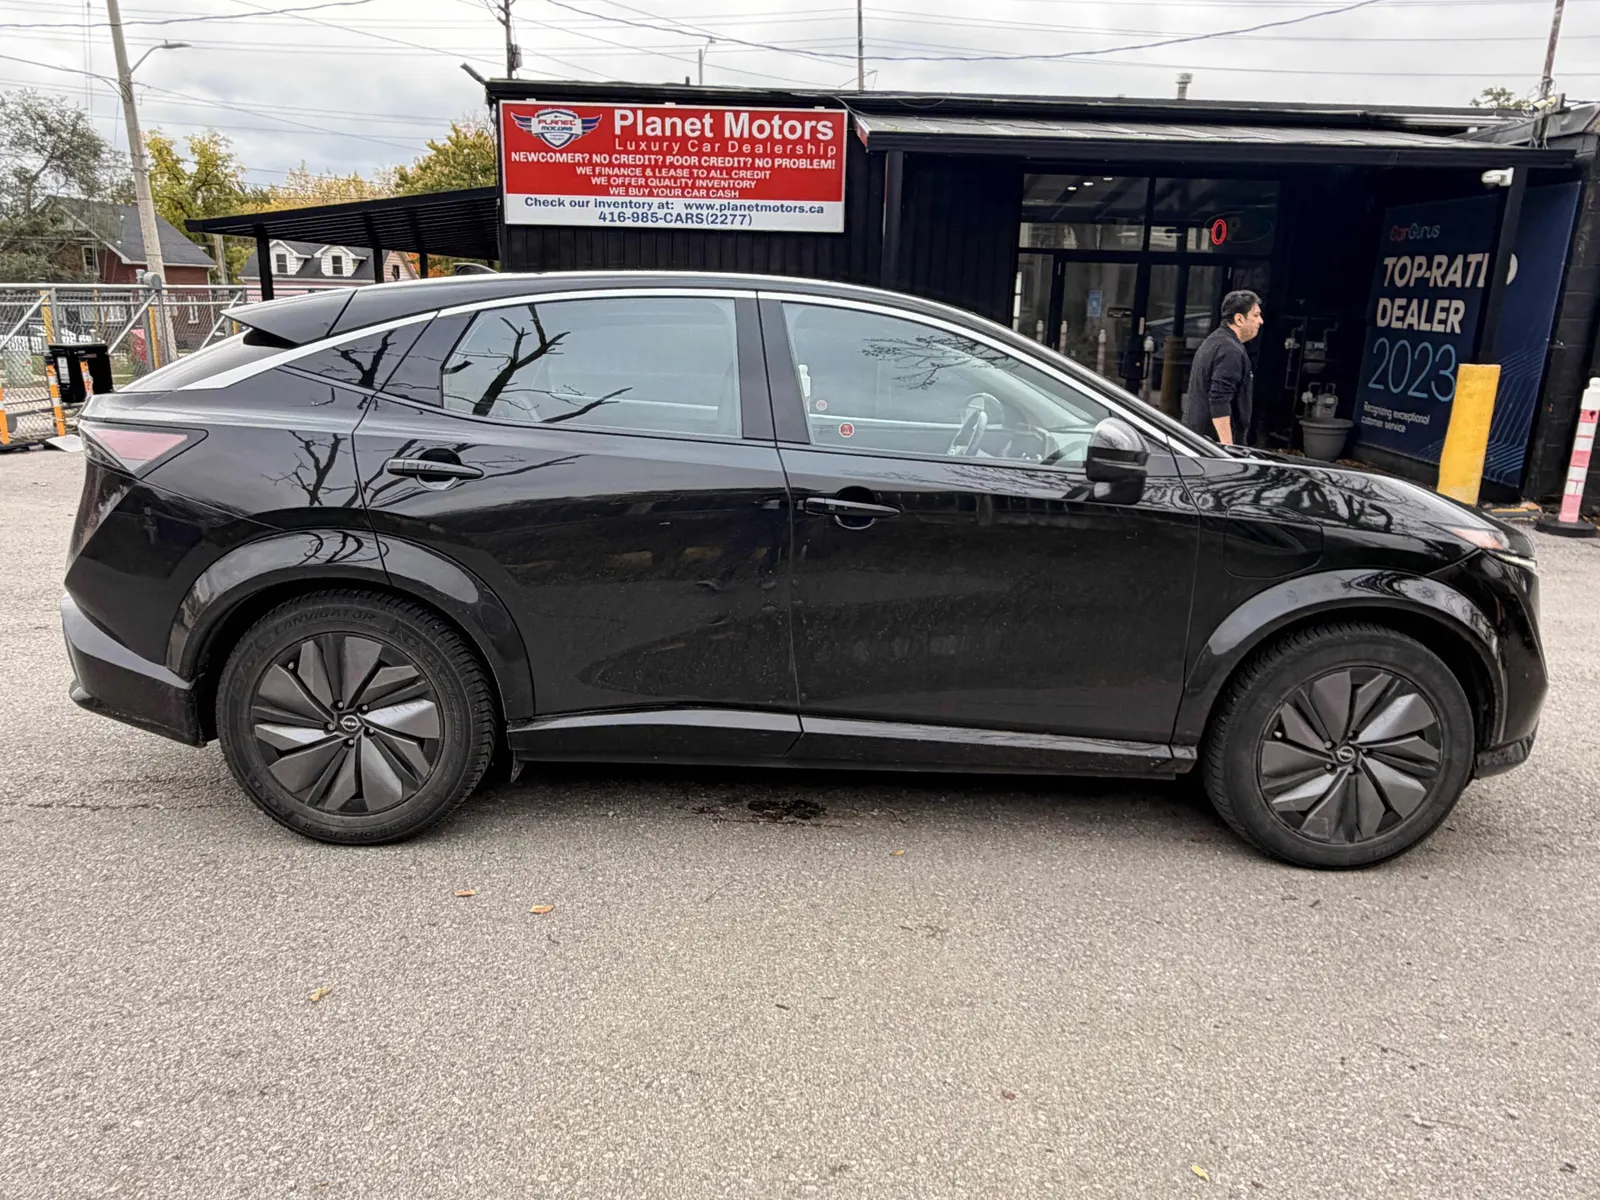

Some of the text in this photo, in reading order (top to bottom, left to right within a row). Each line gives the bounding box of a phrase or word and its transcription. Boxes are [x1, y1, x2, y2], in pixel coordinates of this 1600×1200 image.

[614, 109, 834, 141] Planet Motors
[615, 138, 836, 157] Luxury Car Dealership
[511, 152, 836, 170] NEWCOMER? NO CREDIT? POOR CREDIT? NO PROBLEM!
[576, 166, 771, 179] WE FINANCE & LEASE TO ALL CREDIT
[590, 176, 756, 189] WE OFFER QUALITY INVENTORY
[609, 187, 739, 198] WE BUY YOUR CAR CASH
[525, 196, 566, 207] Check
[569, 199, 590, 208] our
[657, 200, 674, 210] at:
[684, 201, 824, 214] www.planetmotors.ca
[598, 211, 752, 226] 416-985-CARS(2277)
[1390, 222, 1440, 242] CarGurus
[1376, 297, 1465, 334] DEALER
[1368, 337, 1456, 402] 2023
